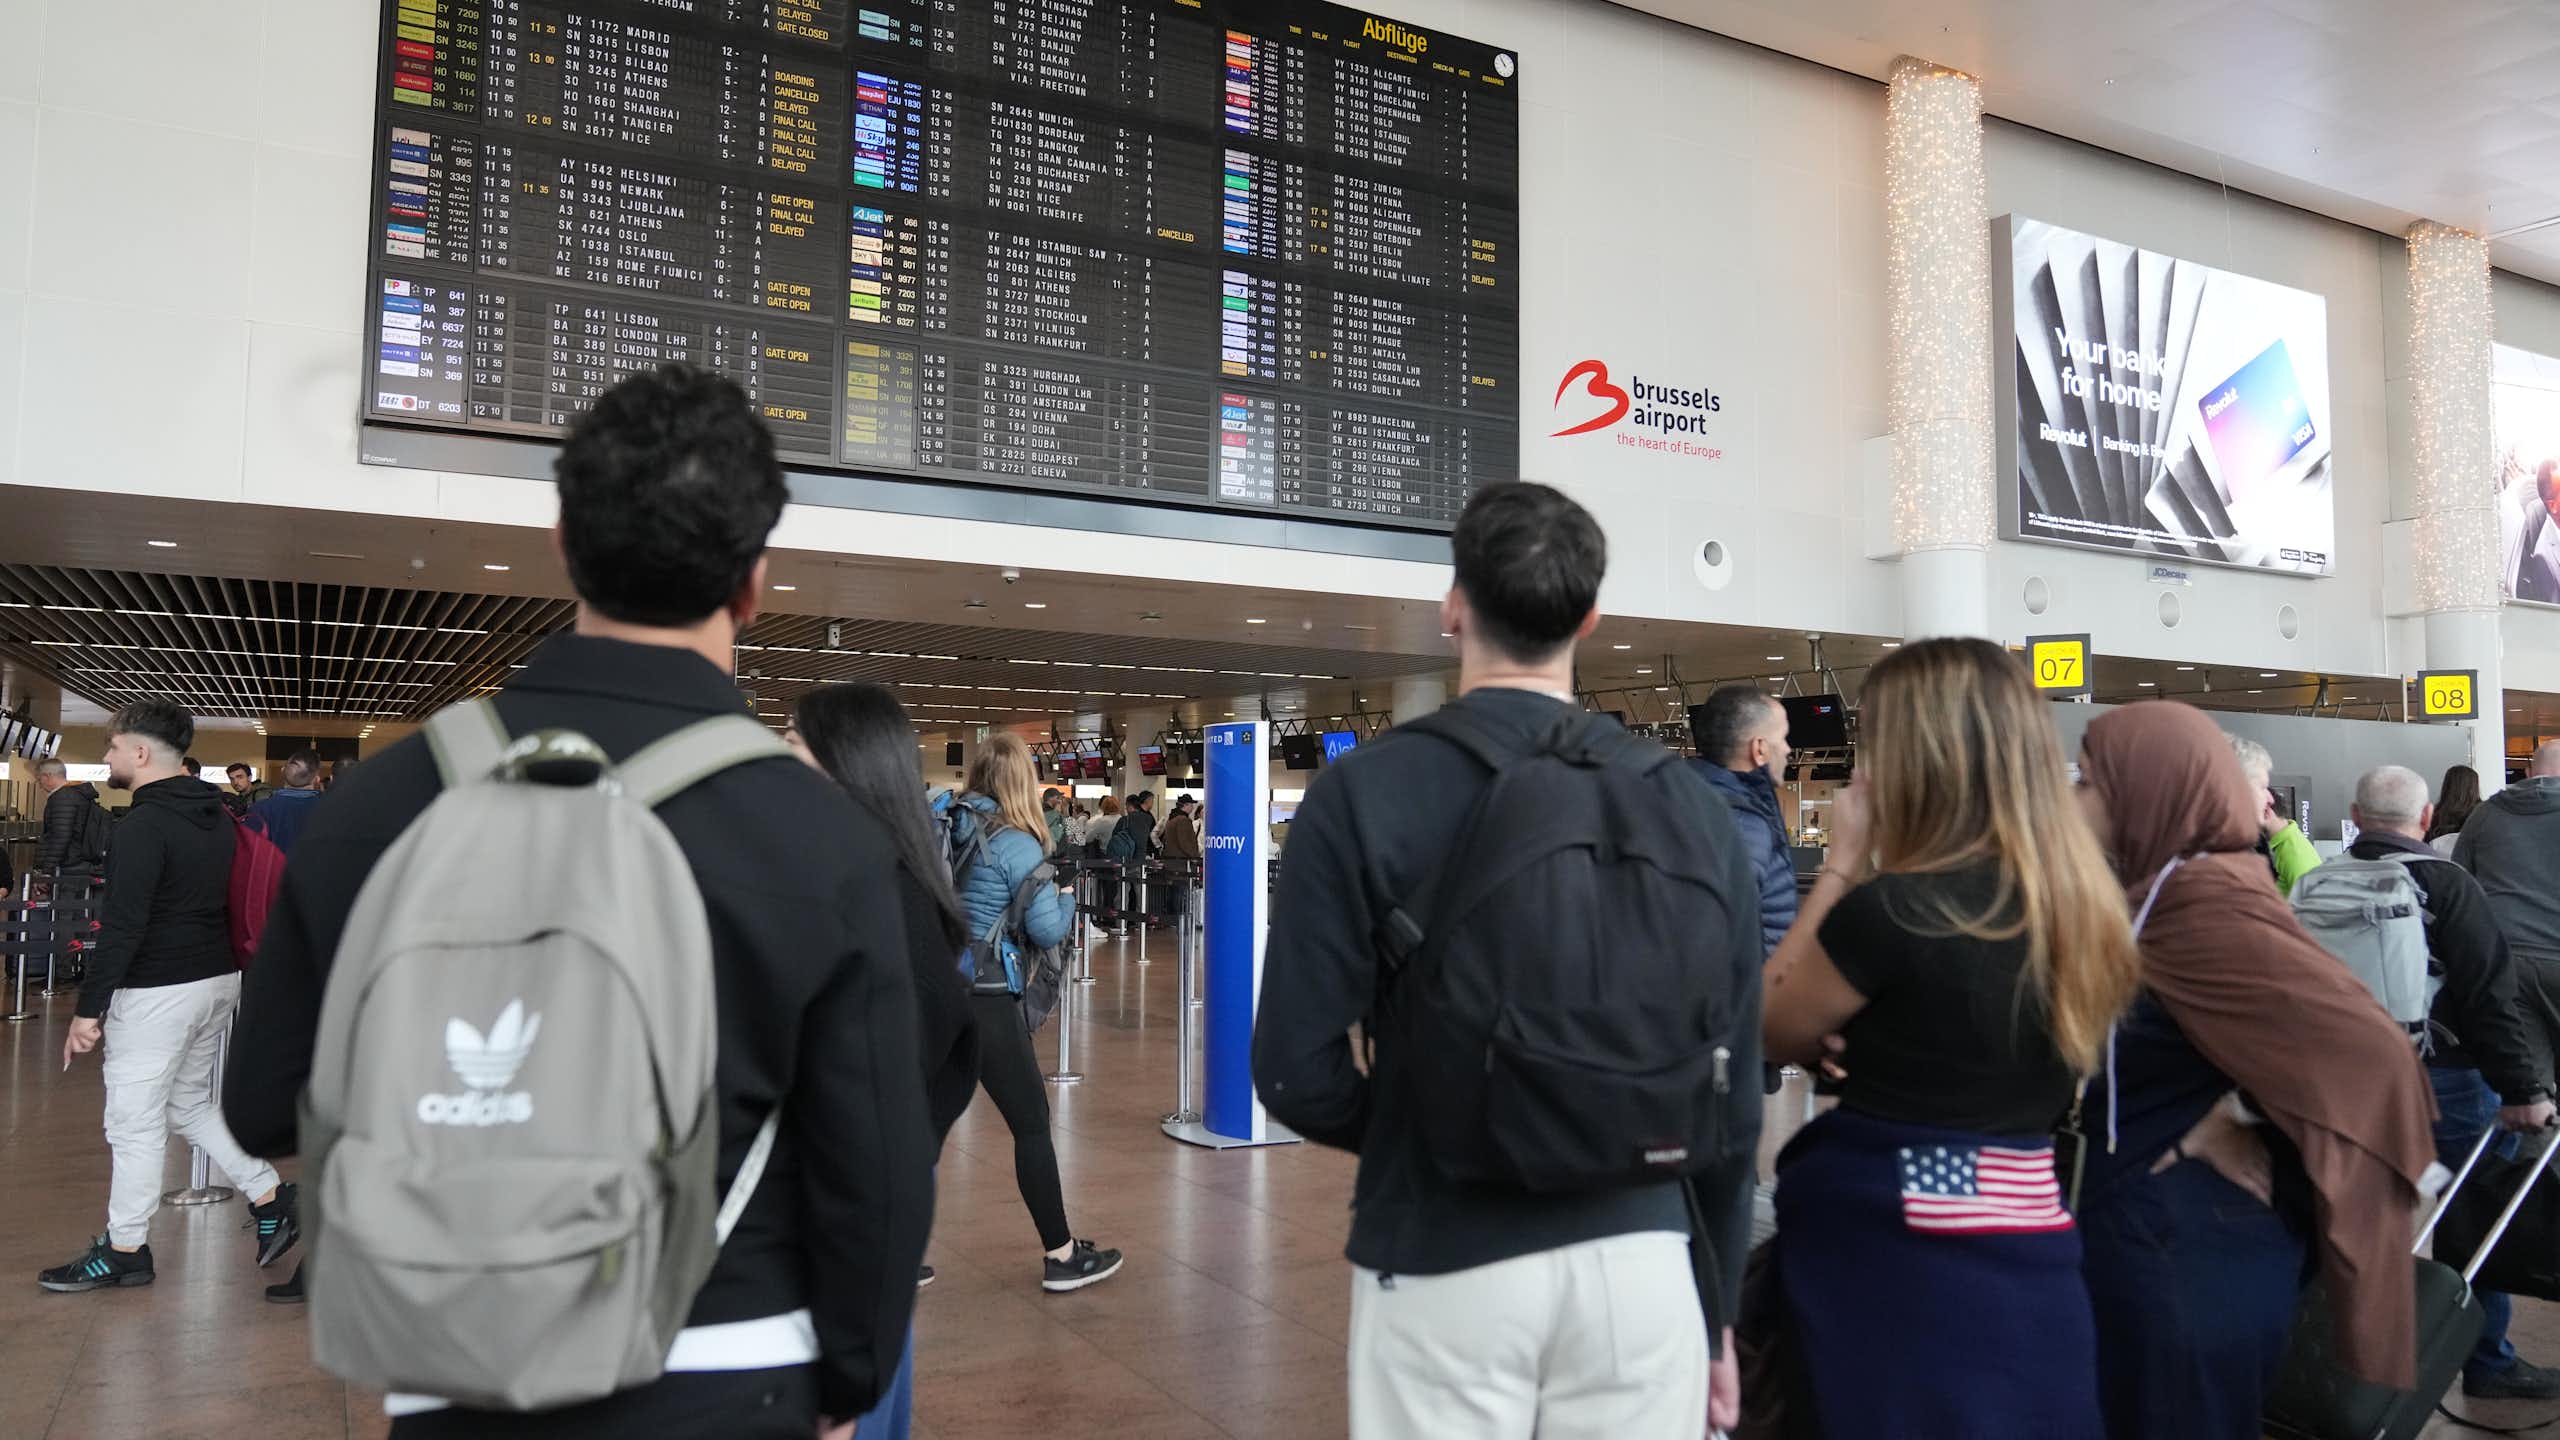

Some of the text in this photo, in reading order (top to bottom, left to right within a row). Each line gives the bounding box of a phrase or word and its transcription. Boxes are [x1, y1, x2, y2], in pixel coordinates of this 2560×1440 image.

[778, 7, 811, 22] DELAYED
[1042, 12, 1081, 29] BEIJING
[627, 26, 669, 43] MADRID
[777, 22, 828, 40] GATE CLOSED
[1042, 26, 1081, 42] CONAKRY
[1363, 17, 1428, 52] Abflüge
[1041, 39, 1075, 54] BANJUL
[626, 42, 668, 58] LISBON
[775, 72, 814, 87] BOARDING
[1041, 52, 1069, 66] DAKAR
[626, 56, 668, 73] BILBAO
[775, 86, 818, 102] CANCELLED
[1040, 66, 1086, 83] MONROVIA
[625, 72, 667, 88] ATHENS
[774, 100, 808, 114] DELAYED
[1040, 79, 1086, 96] FREETOWN
[624, 86, 816, 131] NADOR FINAL CALL
[624, 102, 679, 120] SHANGHAI
[1039, 112, 1073, 126] MUNICH
[624, 116, 816, 160] TANGIER FINAL CALL
[856, 130, 884, 145] HiSky
[1039, 126, 1084, 142] BORDEAUX
[622, 131, 806, 172] NICE DELAYED
[1038, 139, 1078, 154] BANGKOK
[1038, 152, 1107, 173] GRAN CANARIA
[1038, 166, 1090, 183] BUCHAREST
[621, 169, 676, 186] HELSINKI
[771, 194, 791, 206] GATE
[793, 198, 813, 209] OPEN
[620, 184, 814, 224] NEWARK FINAL CALL
[1037, 193, 1060, 204] NICE
[619, 214, 662, 229] ATHENS
[620, 199, 684, 218] LJUBLJANA
[770, 224, 804, 236] DELAYED
[853, 207, 884, 224] AJet
[1038, 206, 1194, 242] TENERIFE CANCELLED
[619, 230, 647, 242] OSLO
[620, 245, 674, 262] ISTANBUL
[1038, 240, 1106, 259] ISTANBUL SAW
[617, 259, 810, 296] ROME FIUMICI GATE OPEN
[1036, 267, 1076, 281] ALGIERS
[617, 275, 810, 310] BEIRUT GATE OPEN
[1036, 281, 1070, 294] ATHENS
[1035, 294, 1069, 307] MADRID
[616, 312, 658, 326] LISBON
[1035, 308, 1087, 324] STOCKHOLM
[1035, 322, 1075, 335] VILNIUS
[615, 328, 658, 342] LONDON
[667, 335, 686, 346] LHR
[766, 348, 786, 358] GATE
[787, 350, 808, 362] OPEN
[1034, 335, 1086, 350] FRANKFURT
[2055, 327, 2167, 378] Your bank
[1034, 370, 1080, 384] HURGHADA
[1034, 383, 1091, 399] LONDON LHR
[1633, 376, 1720, 412] brussels
[2062, 367, 2162, 412] for home
[1033, 397, 1086, 411] AMSTERDAM
[1033, 411, 1067, 423] VIENNA
[1634, 403, 1706, 435] airport
[1032, 424, 1055, 435] DOHA
[2040, 422, 2087, 448] Revolut
[1032, 438, 1059, 449] DUBAI
[1617, 432, 1721, 461] the heart of Europe
[1032, 452, 1078, 465] BUDAPEST
[1032, 466, 1066, 478] GENEVA
[2041, 658, 2076, 681] 07
[2432, 689, 2464, 709] 08
[2302, 800, 2310, 838] Revol
